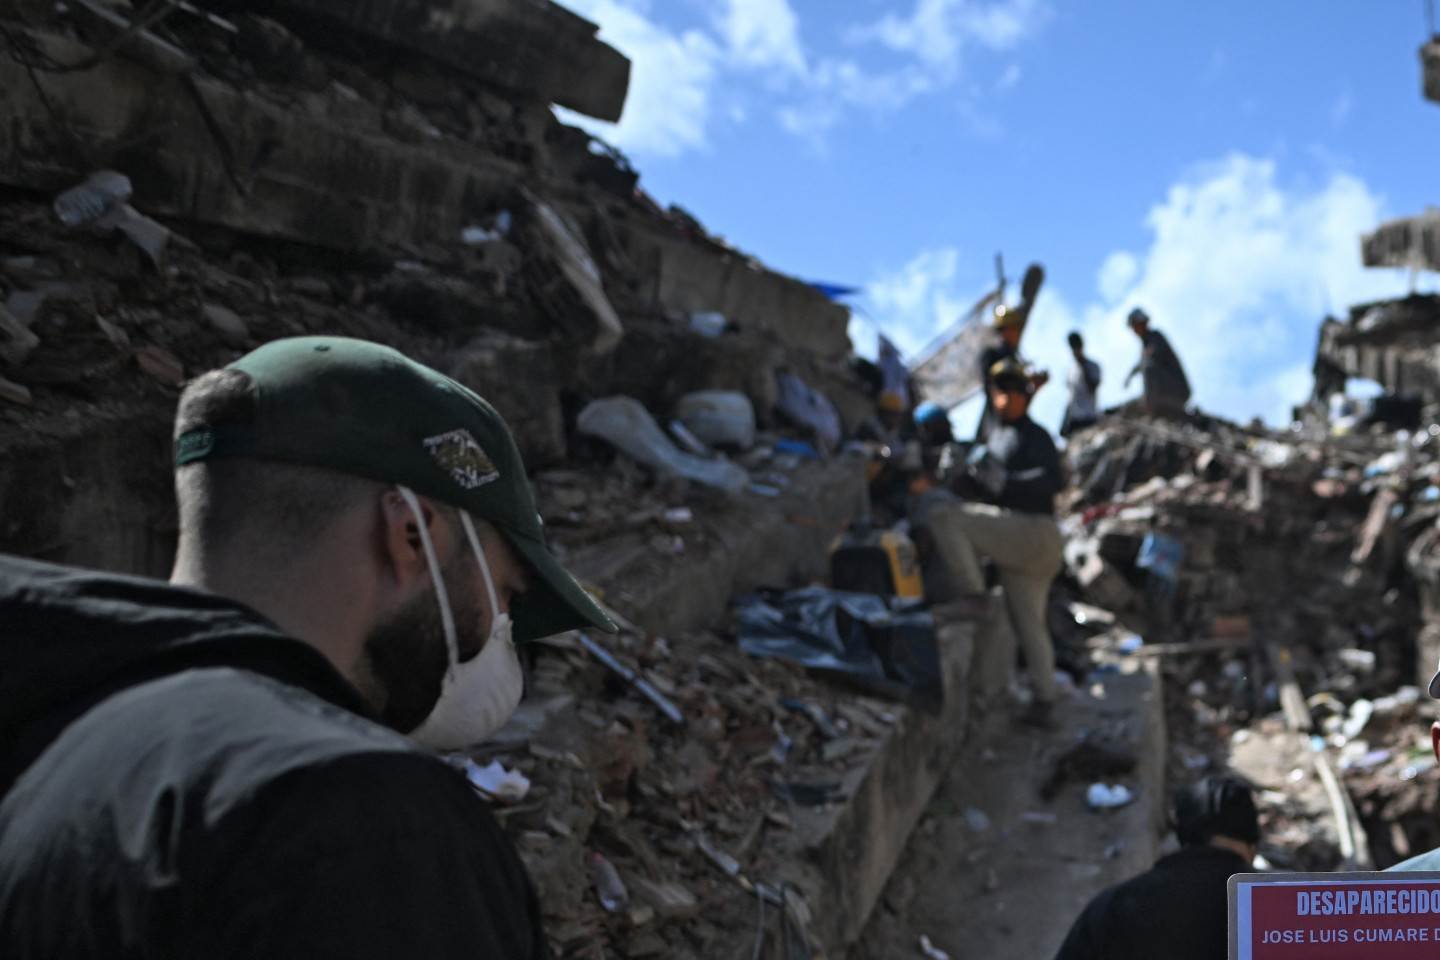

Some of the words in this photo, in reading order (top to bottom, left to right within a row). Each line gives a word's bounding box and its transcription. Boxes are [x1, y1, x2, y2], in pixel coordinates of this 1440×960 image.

[1262, 929, 1304, 944] JOSE
[1310, 928, 1349, 943] LUIS
[1353, 927, 1429, 942] CUMARE
